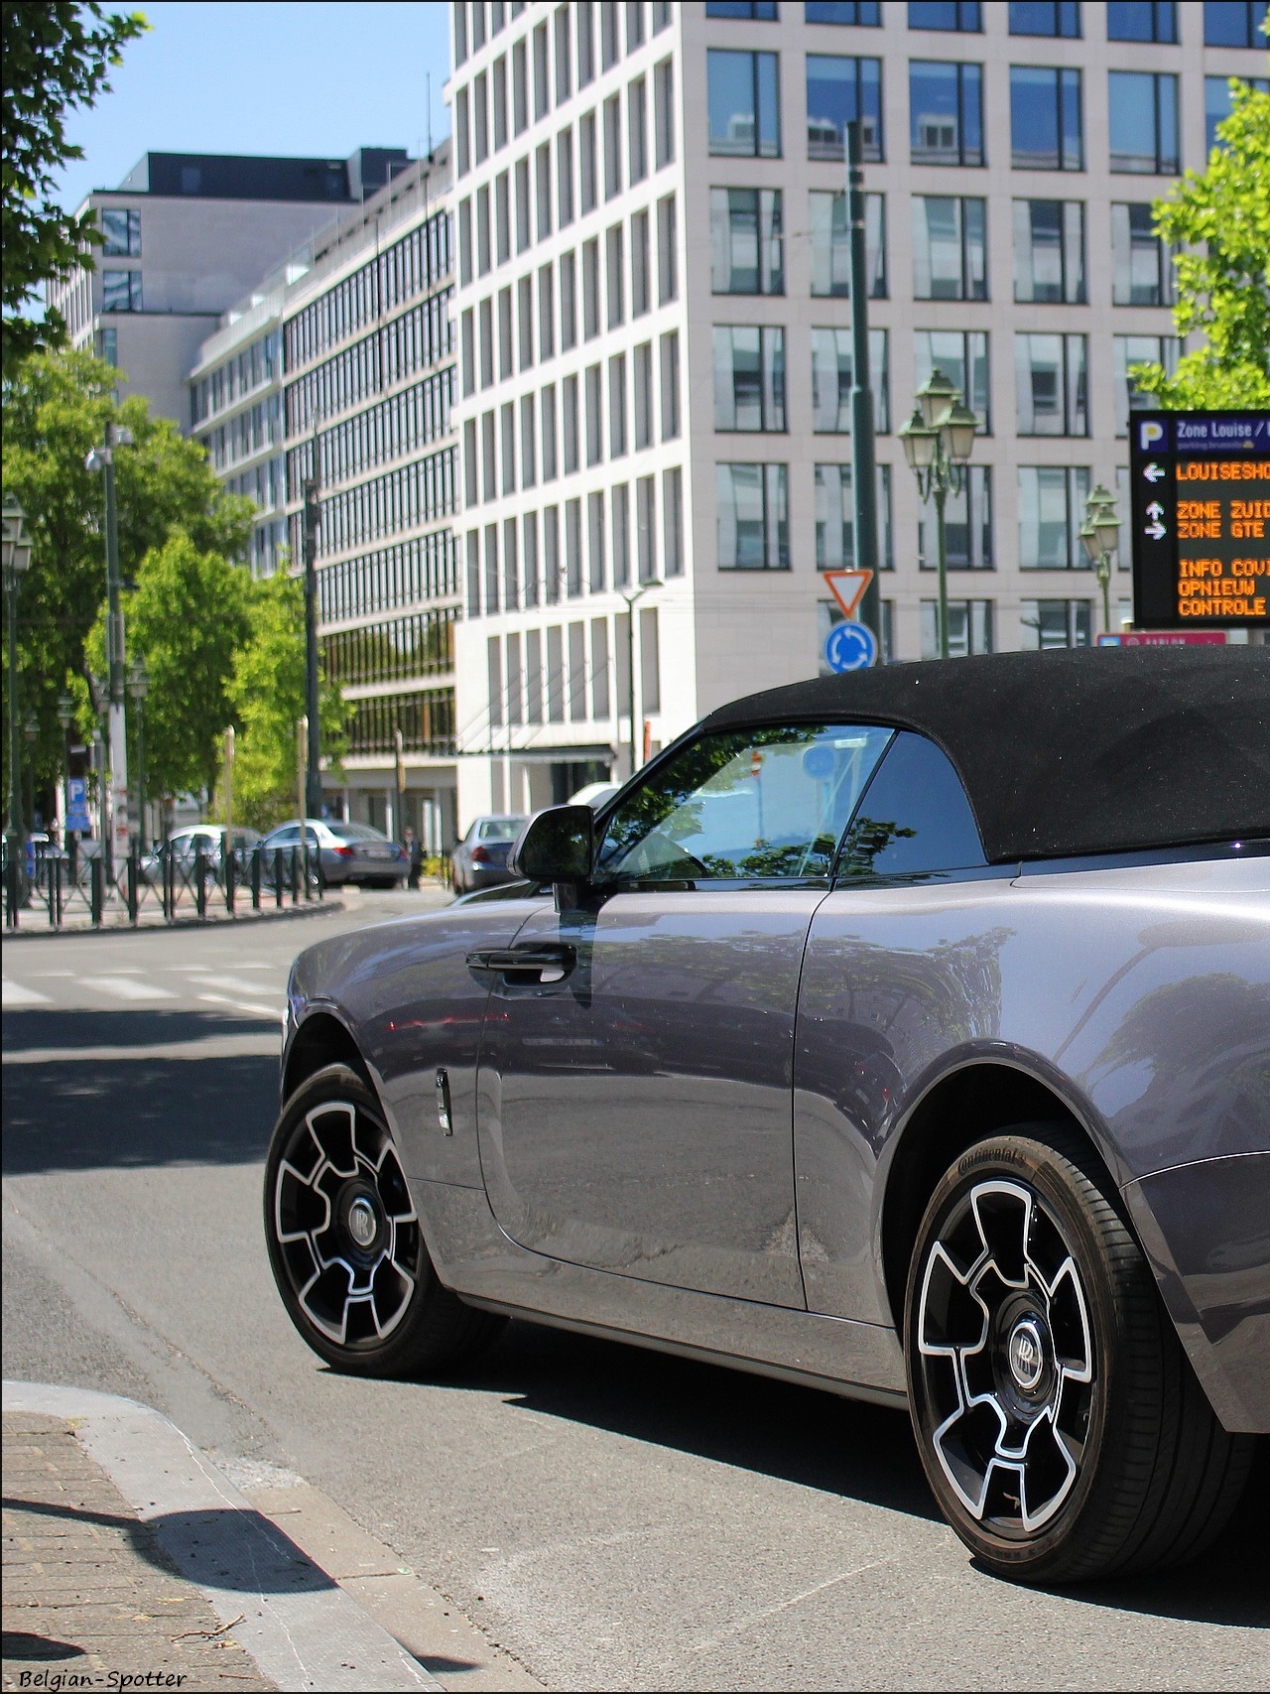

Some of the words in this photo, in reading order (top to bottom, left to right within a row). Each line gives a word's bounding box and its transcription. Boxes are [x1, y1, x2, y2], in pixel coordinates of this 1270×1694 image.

[1140, 421, 1163, 450] P
[1177, 422, 1207, 438] Zone
[1212, 422, 1251, 438] Louise
[1176, 501, 1222, 520] ZONE
[1177, 520, 1222, 539] ZONE
[1230, 520, 1265, 538] GTE
[1179, 559, 1223, 578] INFO
[1178, 579, 1255, 597] OPNIEUW
[1178, 597, 1266, 616] CONTROLE
